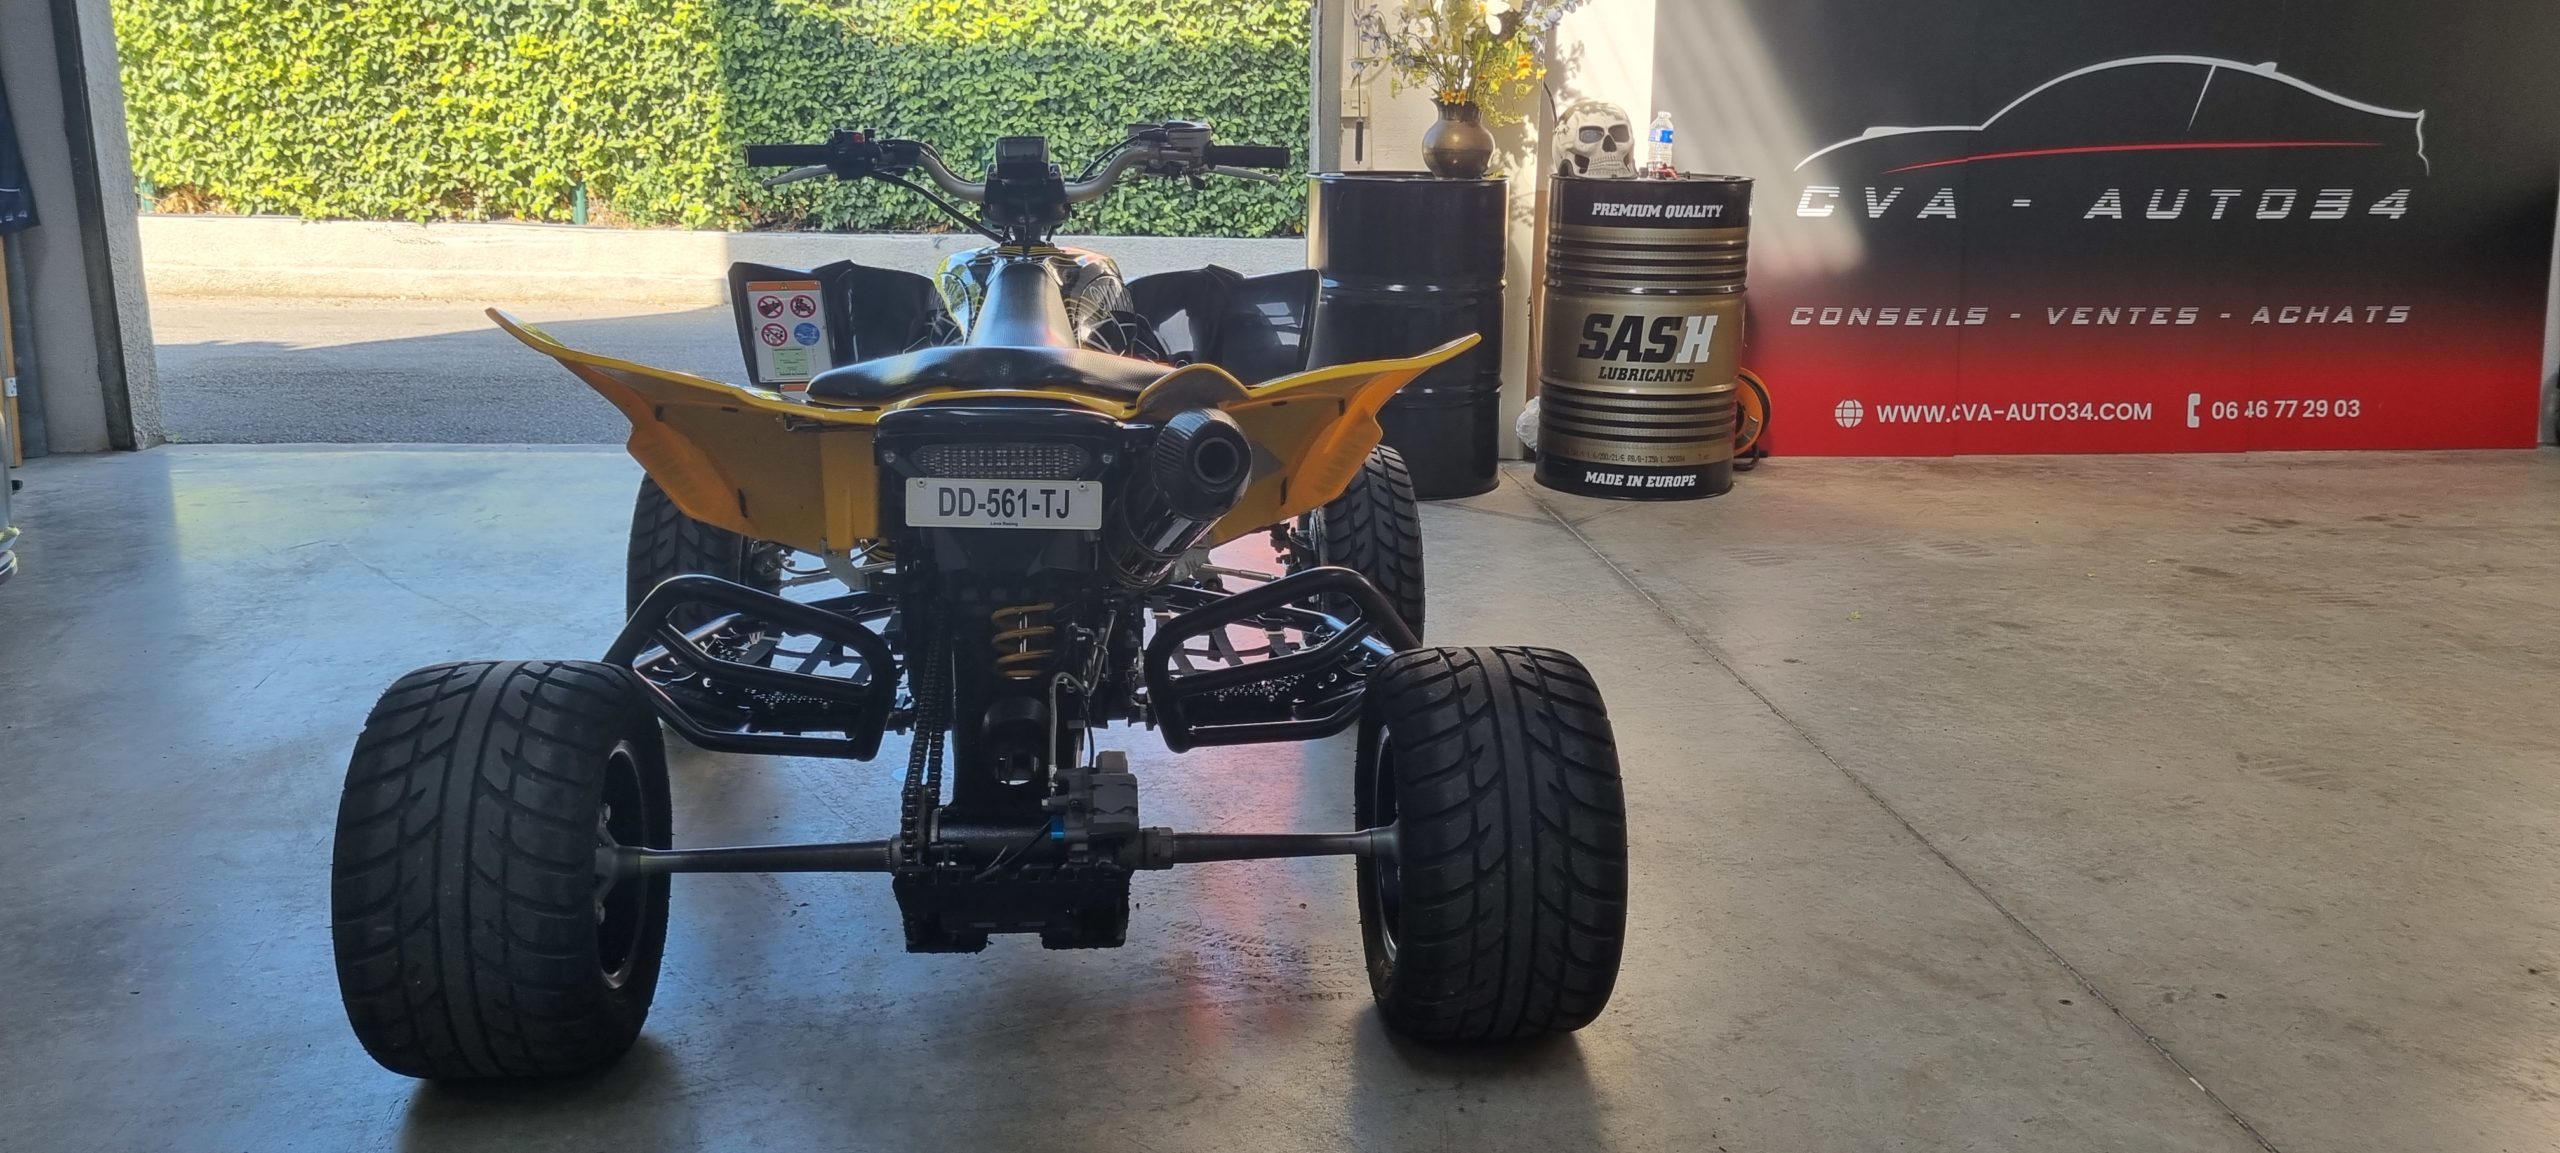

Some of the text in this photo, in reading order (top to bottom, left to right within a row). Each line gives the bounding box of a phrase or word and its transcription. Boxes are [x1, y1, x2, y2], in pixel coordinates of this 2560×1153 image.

[1592, 203, 1723, 219] PREMIUM QUALITY
[1796, 186, 1957, 219] CVA
[2083, 188, 2411, 220] AUTO34
[1790, 307, 1988, 326] CONSEILS
[2047, 307, 2199, 325] VENTES
[2251, 306, 2411, 324] ACHATS
[1577, 313, 1718, 363] SASH
[1598, 366, 1695, 382] LUBRICANTS
[2211, 400, 2360, 420] 06 46 77 29 03
[1585, 471, 1697, 488] MADE IN EUROPE
[938, 487, 1070, 519] DD-561-TJ
